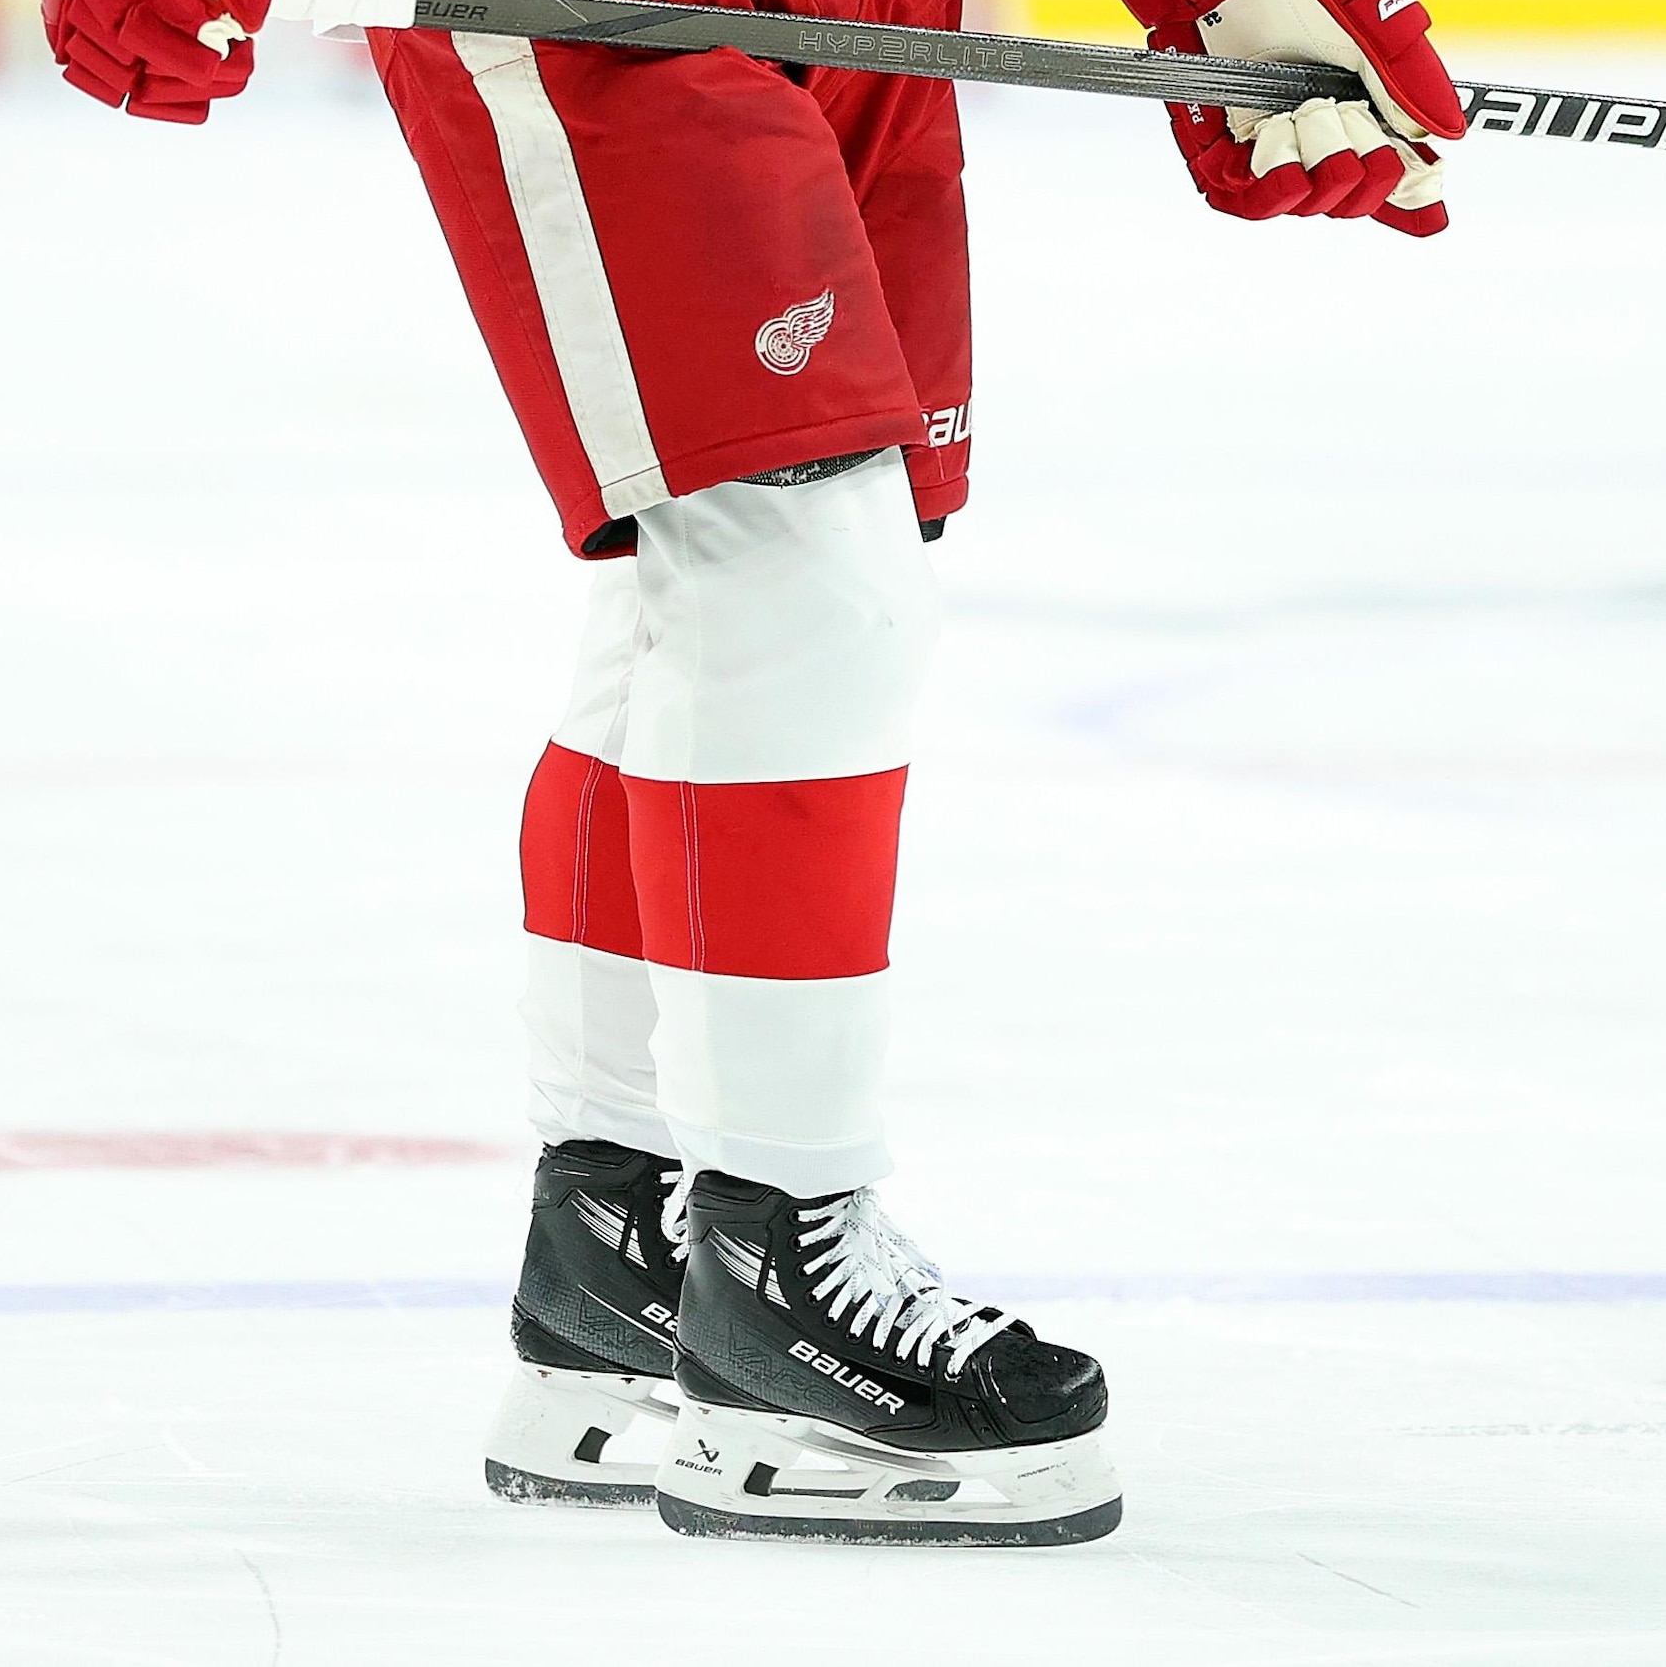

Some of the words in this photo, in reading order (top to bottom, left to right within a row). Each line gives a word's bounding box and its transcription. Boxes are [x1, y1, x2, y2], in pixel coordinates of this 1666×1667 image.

[416, 1, 488, 21] AUER
[787, 1339, 905, 1416] BAUER
[674, 1458, 723, 1476] BAUER
